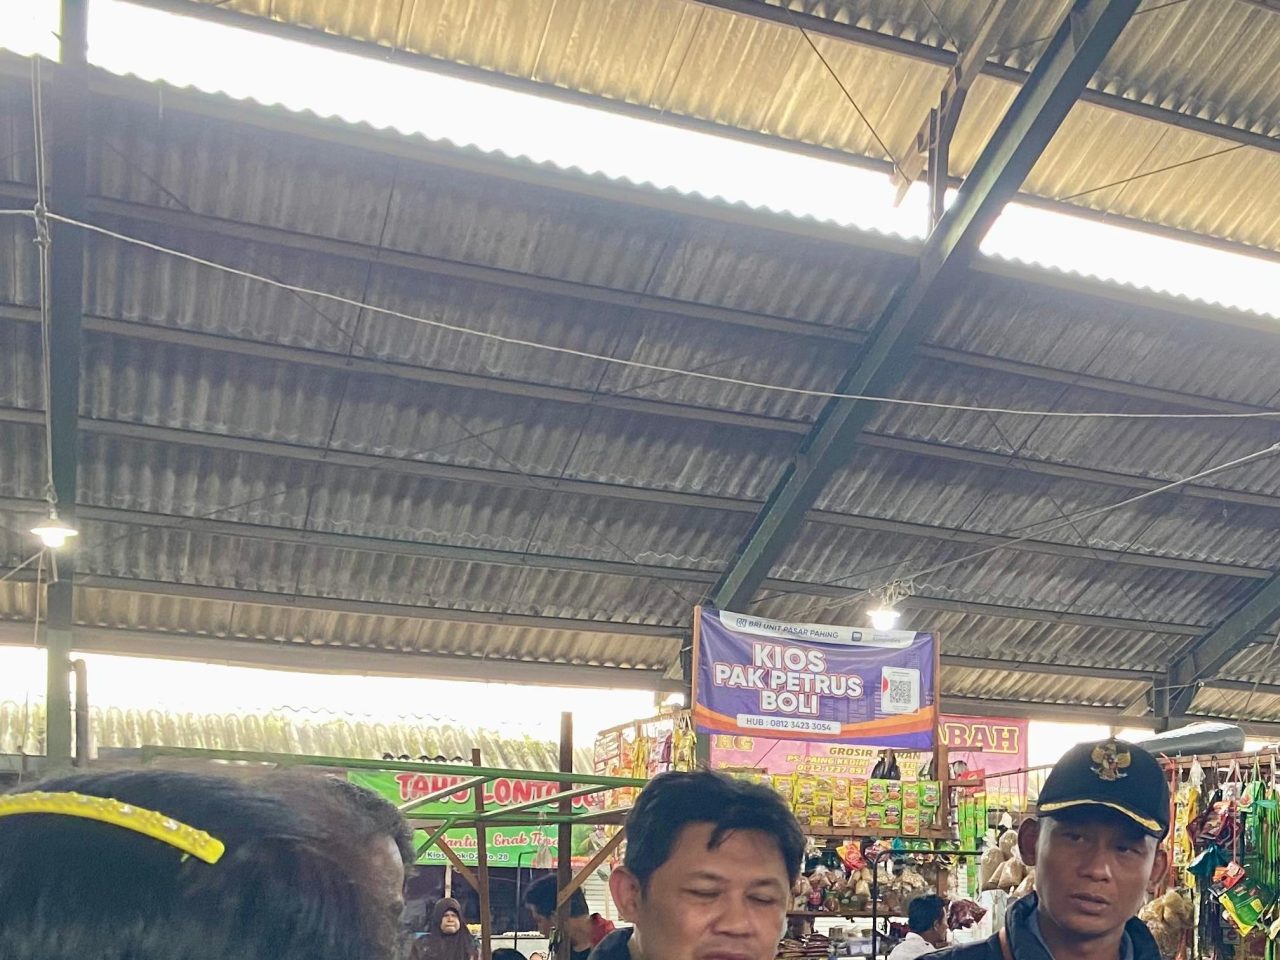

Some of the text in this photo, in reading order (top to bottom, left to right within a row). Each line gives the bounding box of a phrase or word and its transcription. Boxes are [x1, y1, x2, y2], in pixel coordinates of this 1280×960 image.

[763, 623, 782, 632] UNIT
[782, 627, 809, 636] PASAR
[809, 630, 839, 639] PAHING
[753, 643, 825, 673] KIOS
[715, 664, 863, 697] PAK PETRUS
[761, 691, 819, 715] BOLI
[746, 717, 764, 727] HUB
[770, 719, 789, 729] 0812
[790, 720, 810, 730] 3423
[811, 722, 832, 731] 3054
[938, 722, 1019, 753] BAH
[829, 747, 873, 758] GROSIR
[395, 773, 470, 803] TAHU
